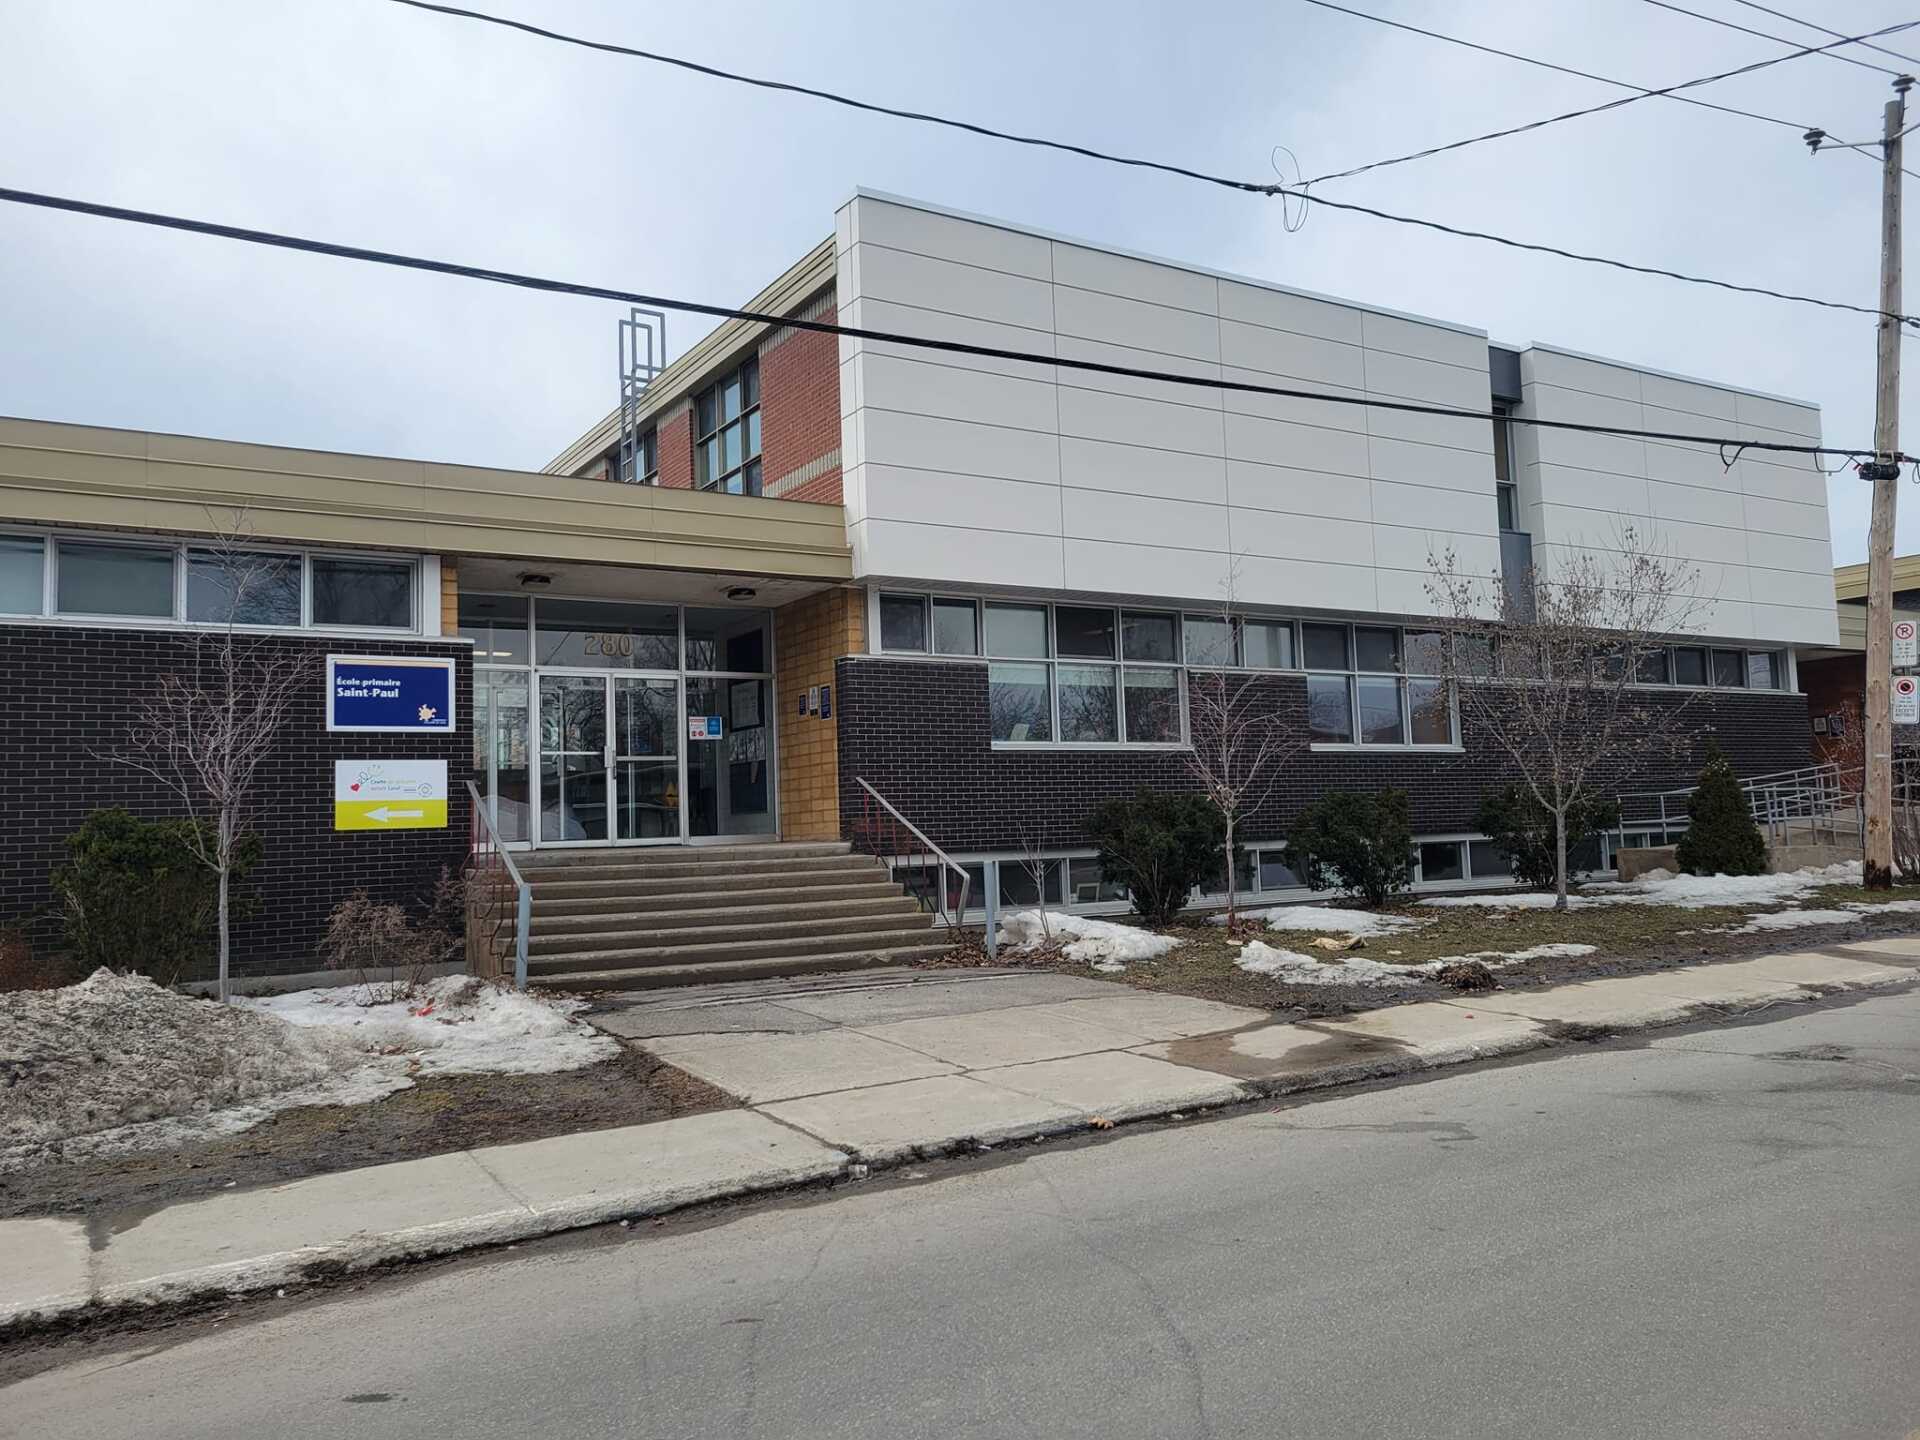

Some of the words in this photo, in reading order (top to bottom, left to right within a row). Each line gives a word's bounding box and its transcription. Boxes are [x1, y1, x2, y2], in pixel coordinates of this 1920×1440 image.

[584, 633, 633, 656] 280
[336, 676, 360, 685] École
[362, 678, 401, 688] primaire
[337, 687, 399, 698] Saint-Paul
